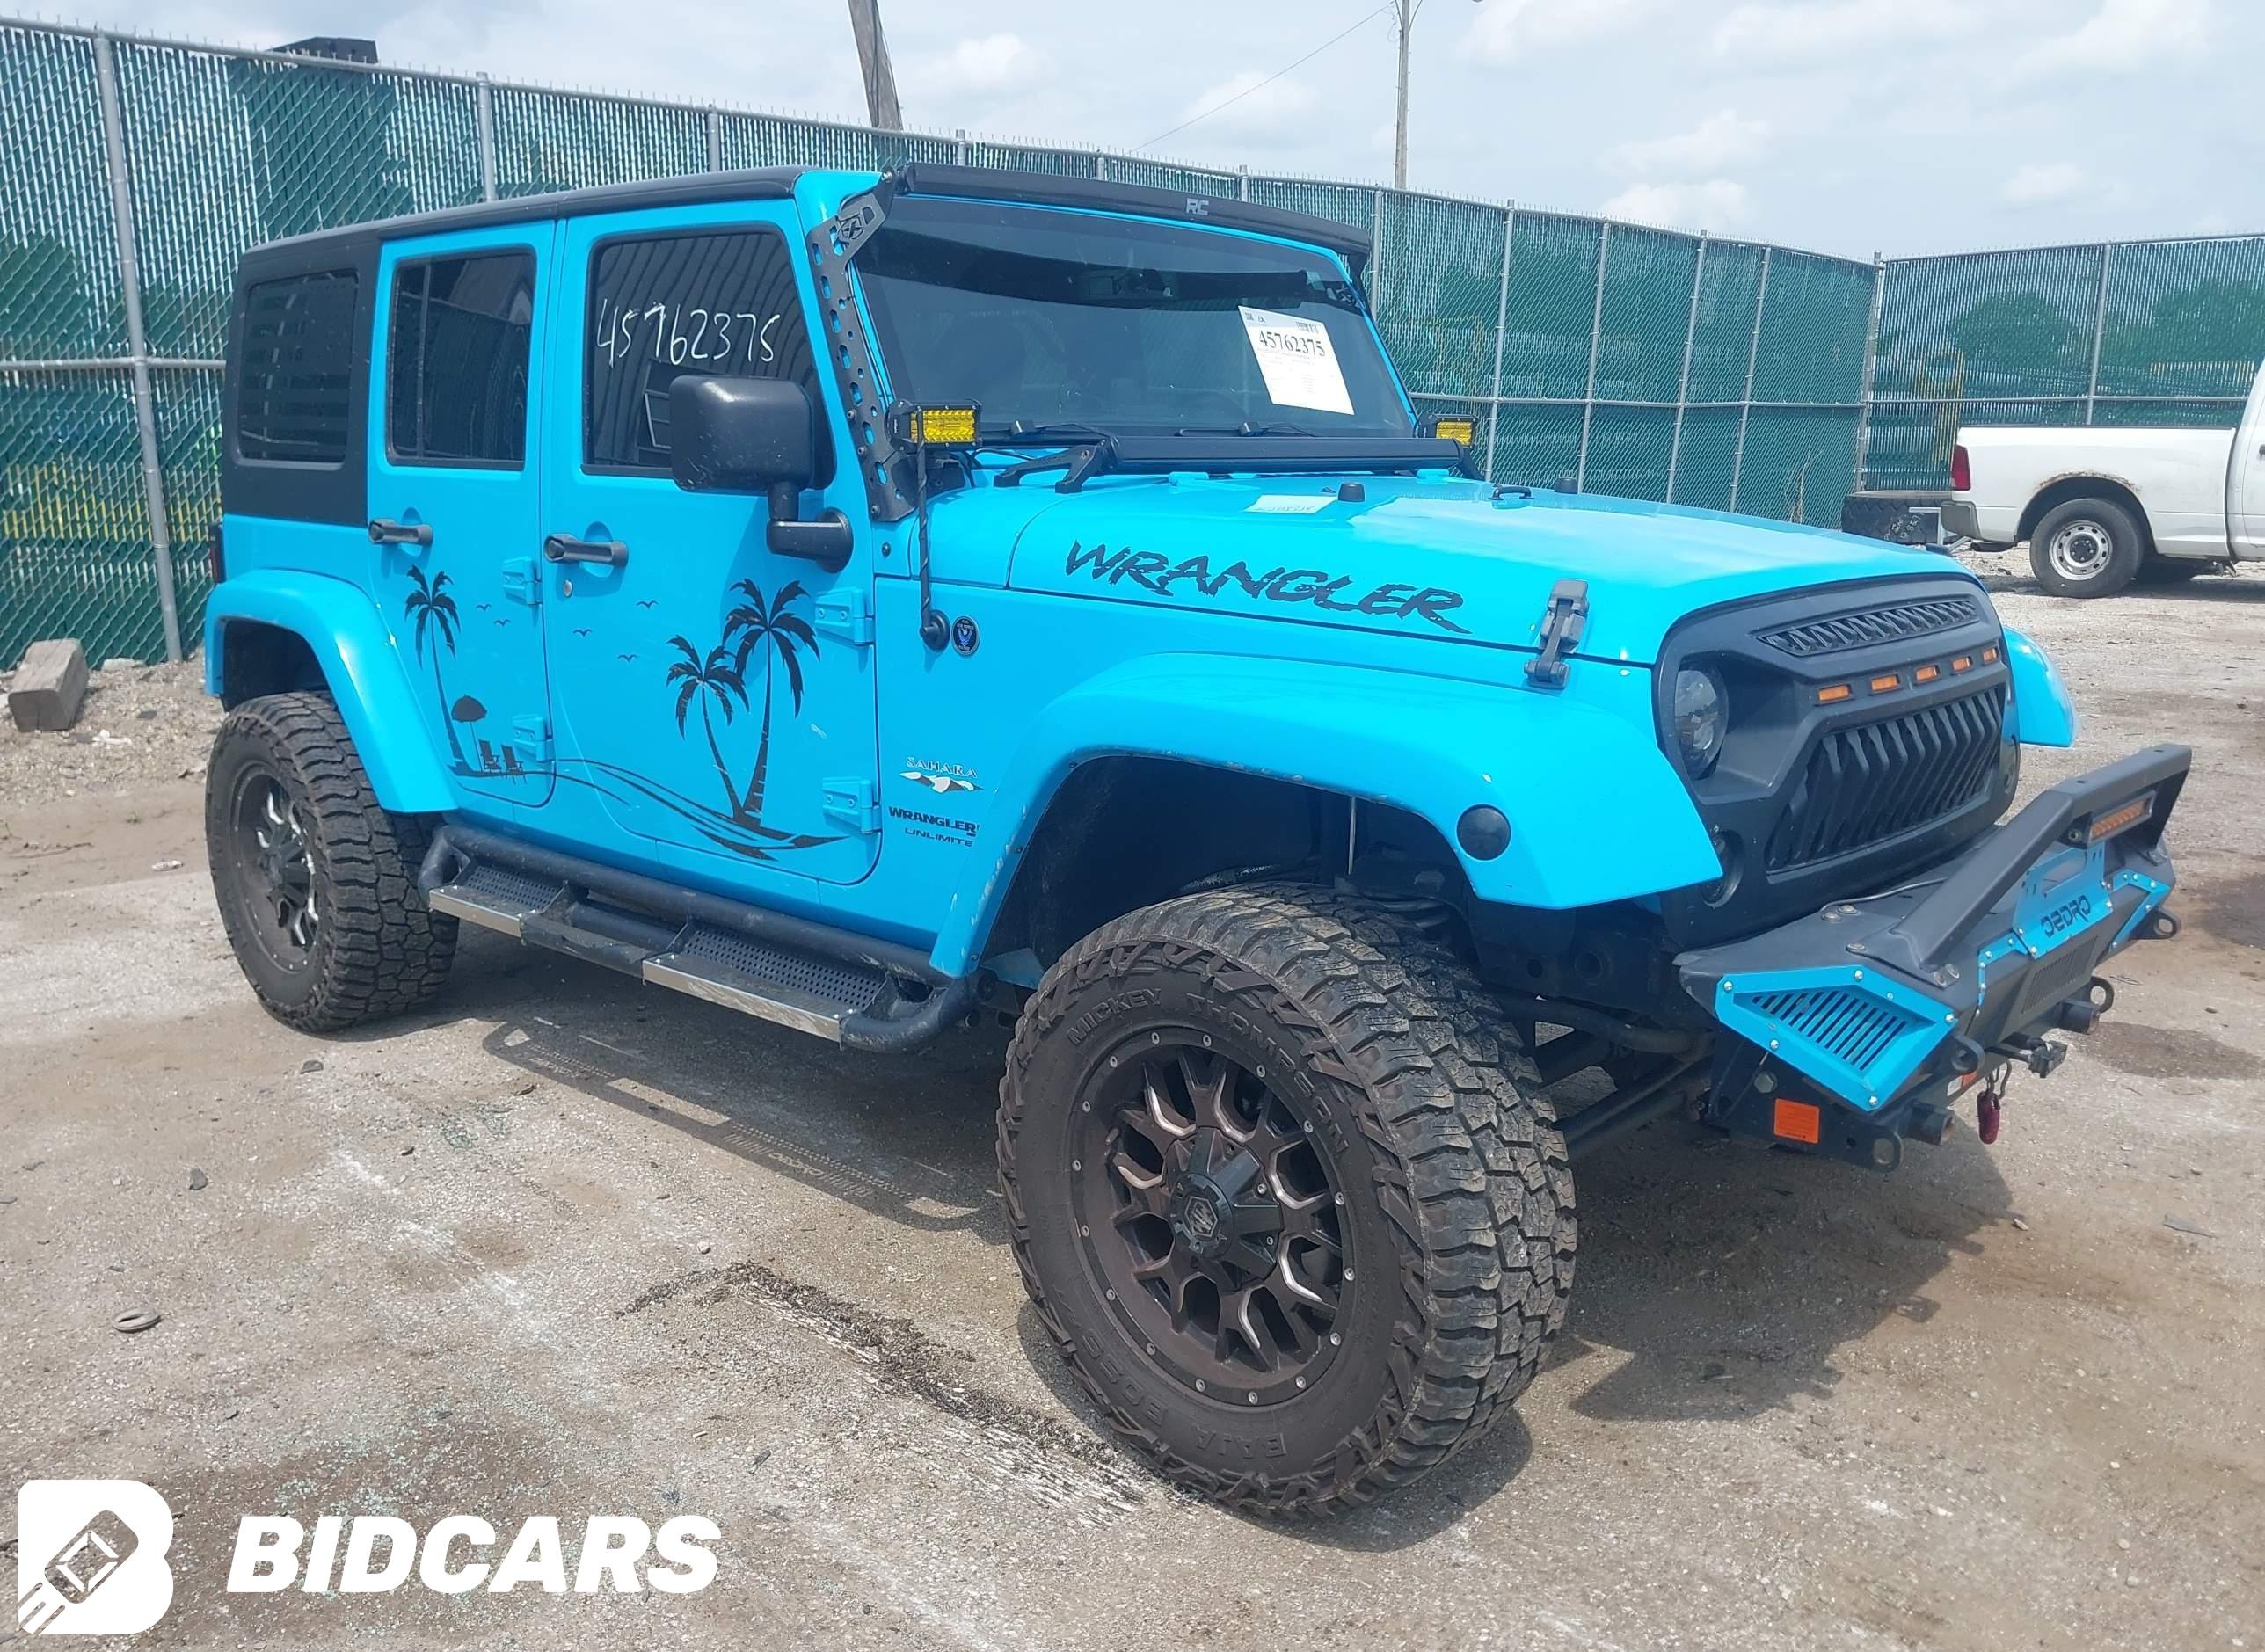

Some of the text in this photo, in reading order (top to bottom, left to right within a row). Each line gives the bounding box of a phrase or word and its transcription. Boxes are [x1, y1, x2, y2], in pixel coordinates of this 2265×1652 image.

[596, 298, 781, 368] 45762375
[1258, 330, 1326, 357] 45762375
[1065, 539, 1474, 634] WRANGLER
[906, 756, 977, 779] SAHARA
[888, 806, 977, 833] WRANGLER
[1066, 986, 1162, 1046] MICKEY
